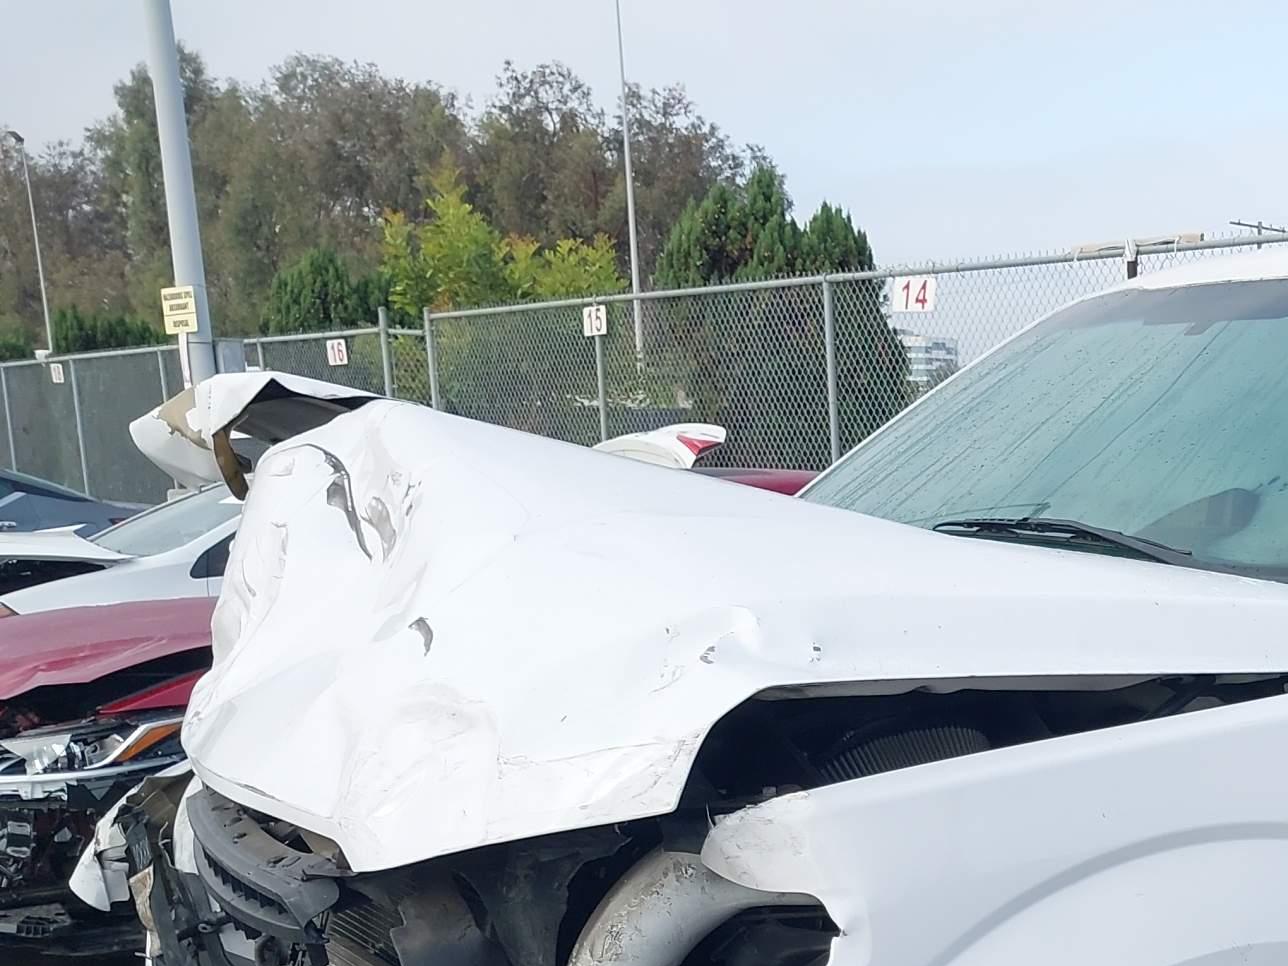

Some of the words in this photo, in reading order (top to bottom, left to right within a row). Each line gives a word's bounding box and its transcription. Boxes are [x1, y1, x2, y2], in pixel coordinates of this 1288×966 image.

[902, 279, 928, 310] 14
[587, 307, 603, 334] 15
[331, 341, 344, 363] 16
